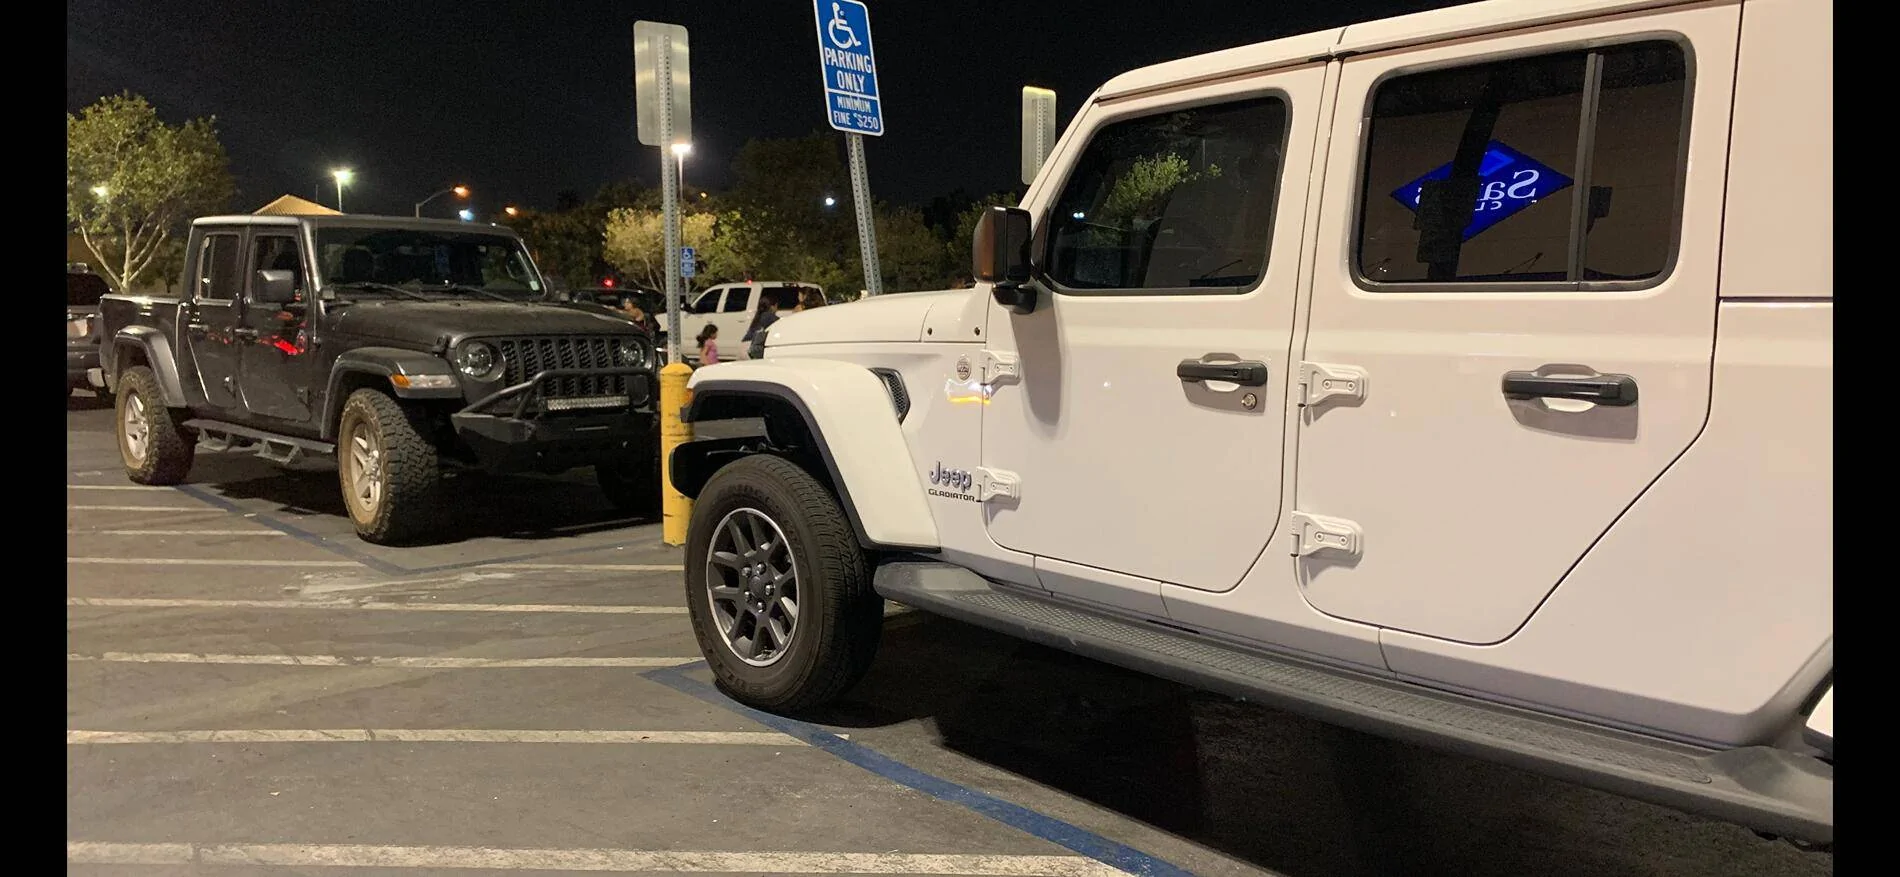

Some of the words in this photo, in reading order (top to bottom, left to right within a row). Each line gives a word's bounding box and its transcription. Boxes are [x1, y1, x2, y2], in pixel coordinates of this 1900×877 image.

[824, 47, 872, 73] PARKING
[837, 71, 865, 92] ONLY
[837, 95, 872, 113] MINIMUM
[834, 111, 851, 125] FINE
[855, 114, 878, 129] $250
[929, 461, 972, 493] Jeep
[928, 488, 975, 502] GLADIATOR
